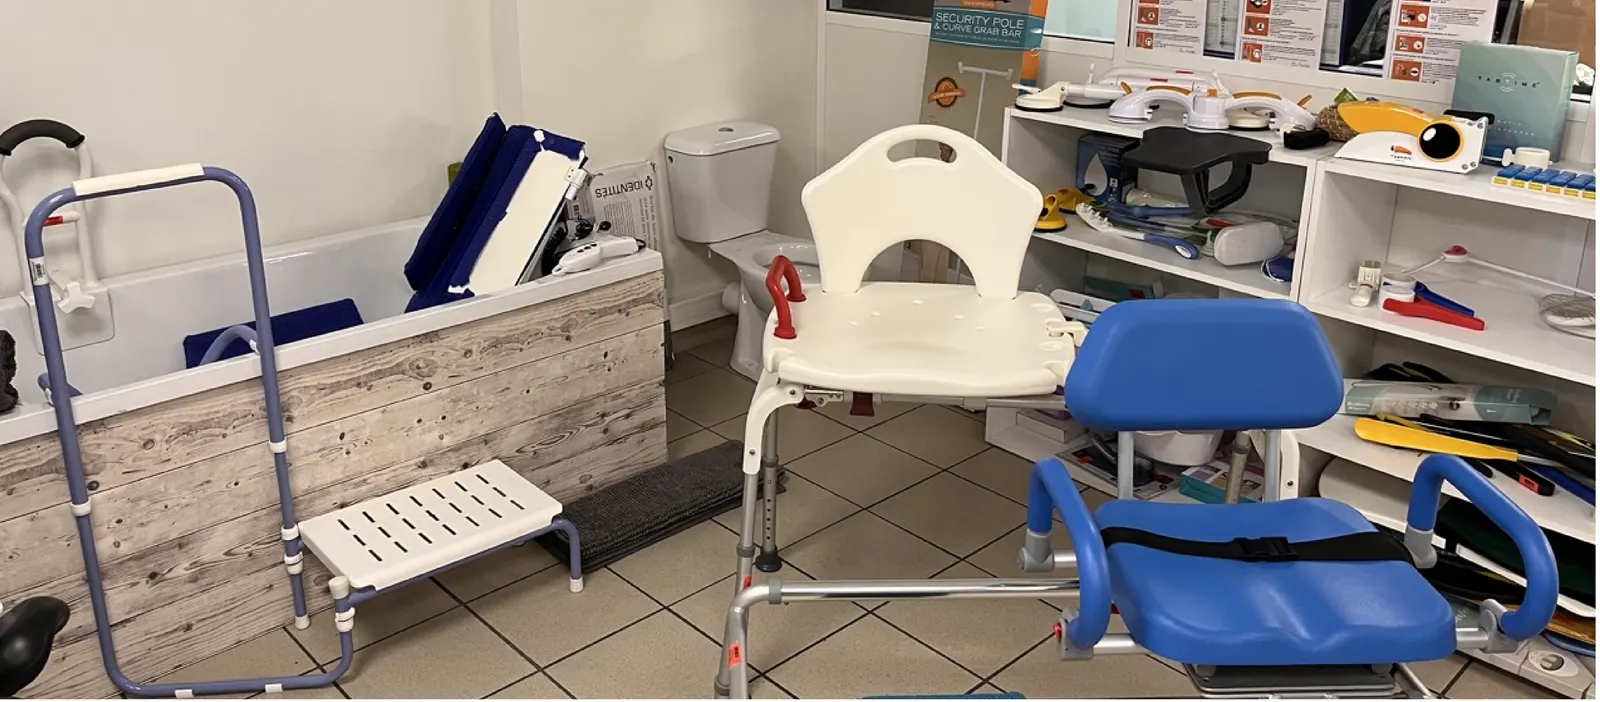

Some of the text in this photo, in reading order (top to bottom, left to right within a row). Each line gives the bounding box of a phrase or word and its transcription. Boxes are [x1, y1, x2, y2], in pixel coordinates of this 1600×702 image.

[936, 12, 1025, 30] SECURITY POLE
[942, 23, 971, 33] CURVE
[973, 26, 999, 36] GRAB
[1002, 28, 1021, 38] BAR
